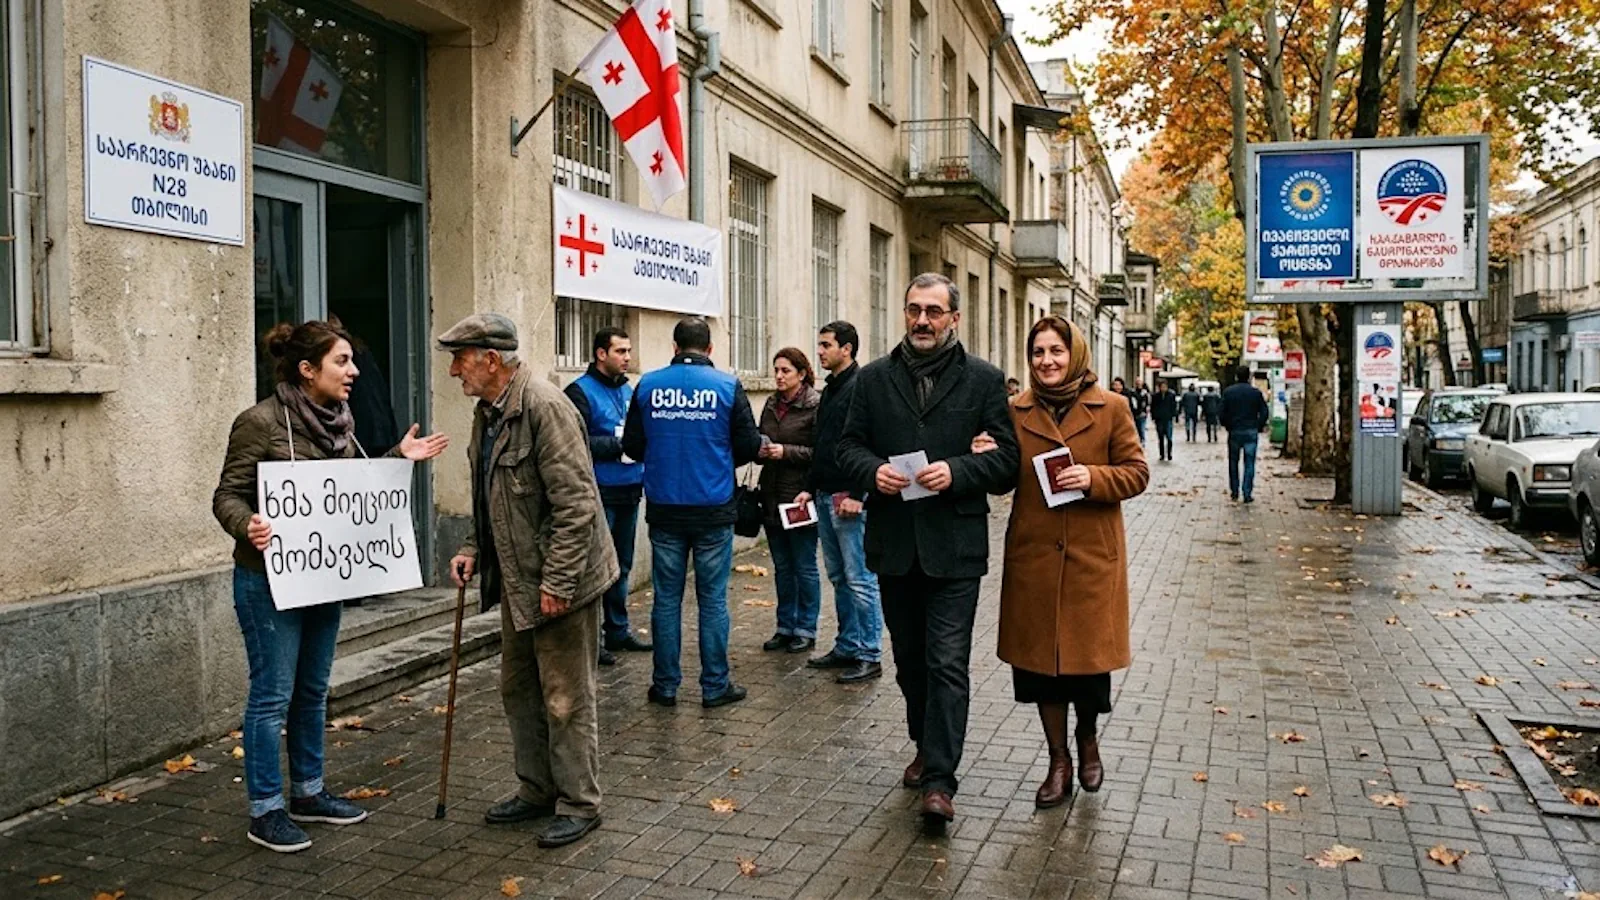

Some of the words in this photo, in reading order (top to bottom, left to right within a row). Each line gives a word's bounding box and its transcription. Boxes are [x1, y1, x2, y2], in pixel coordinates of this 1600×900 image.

[96, 134, 189, 172] საარჩევნო
[193, 156, 236, 182] უბანი
[153, 174, 187, 197] N28
[132, 196, 208, 226] თბილისი
[651, 388, 718, 409] ცესკო
[264, 479, 312, 519] ხმა
[323, 478, 408, 526] მიეცით
[269, 523, 405, 580] მომავალს
